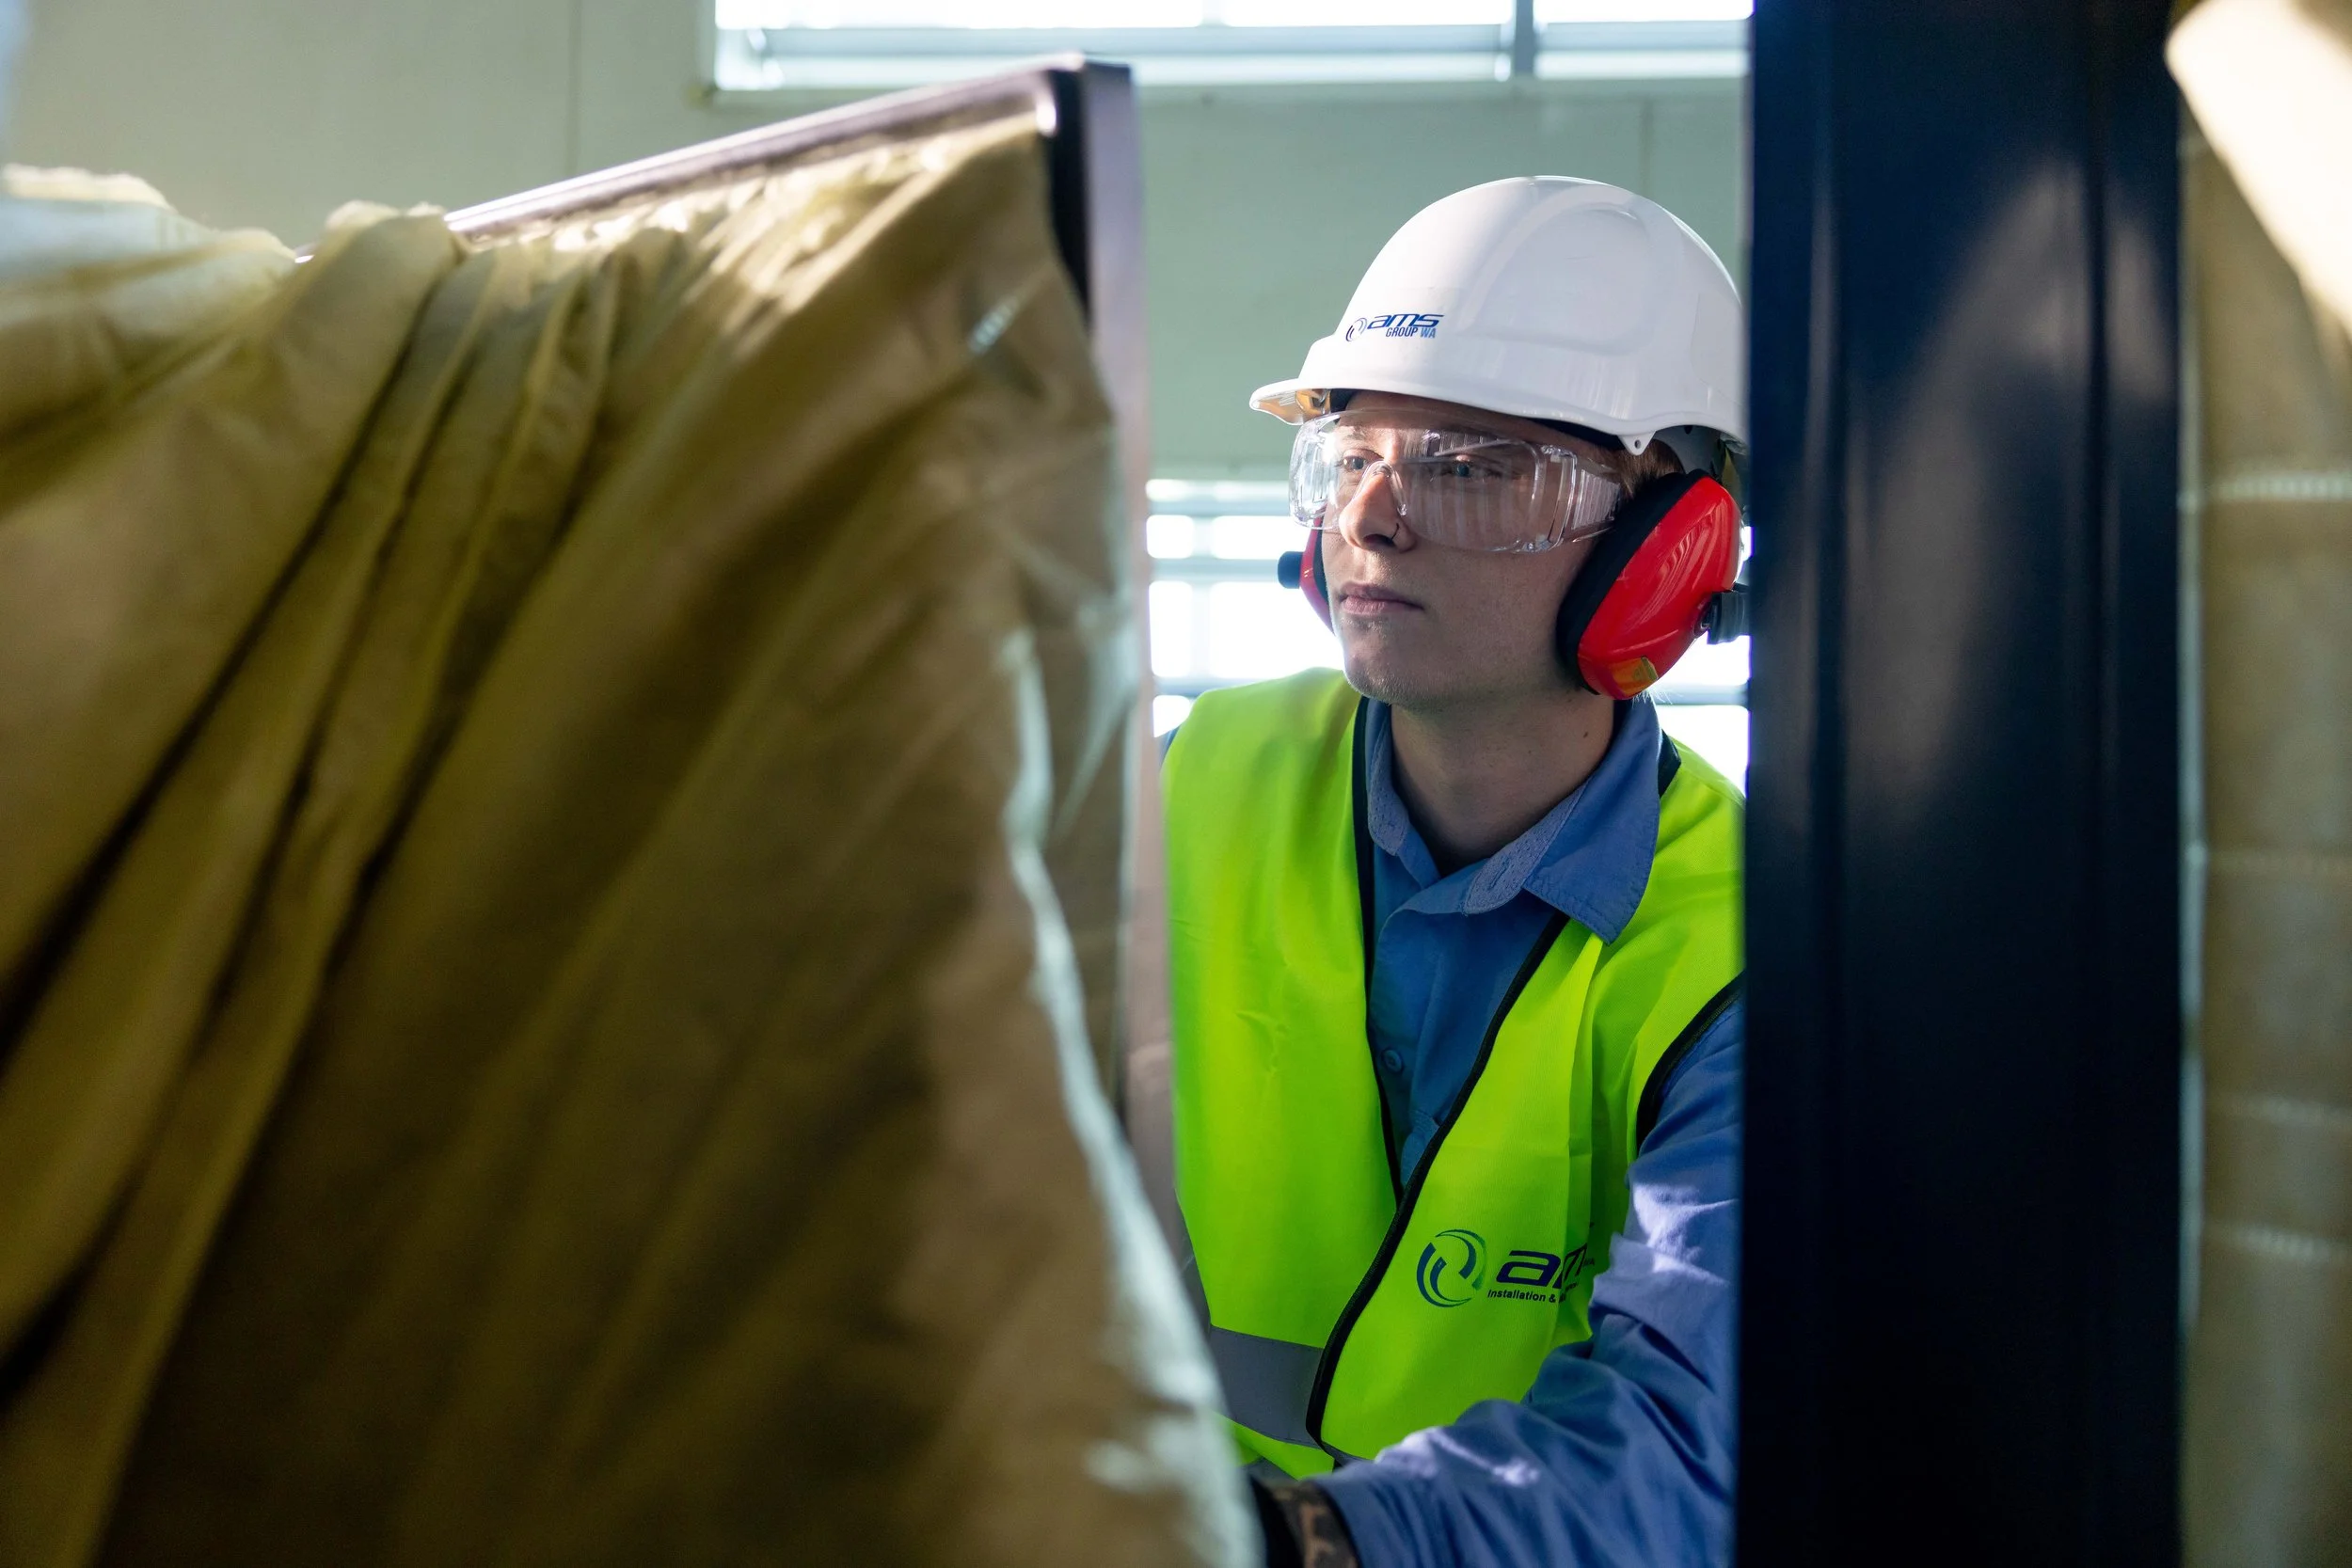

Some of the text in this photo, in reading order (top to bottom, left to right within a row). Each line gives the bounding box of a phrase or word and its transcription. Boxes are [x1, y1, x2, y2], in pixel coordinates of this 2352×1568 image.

[1367, 313, 1444, 329] ams
[1386, 326, 1436, 338] GROUP WA
[1496, 1243, 1587, 1289] am
[1487, 1289, 1546, 1302] Installation
[1549, 1293, 1556, 1303] &
